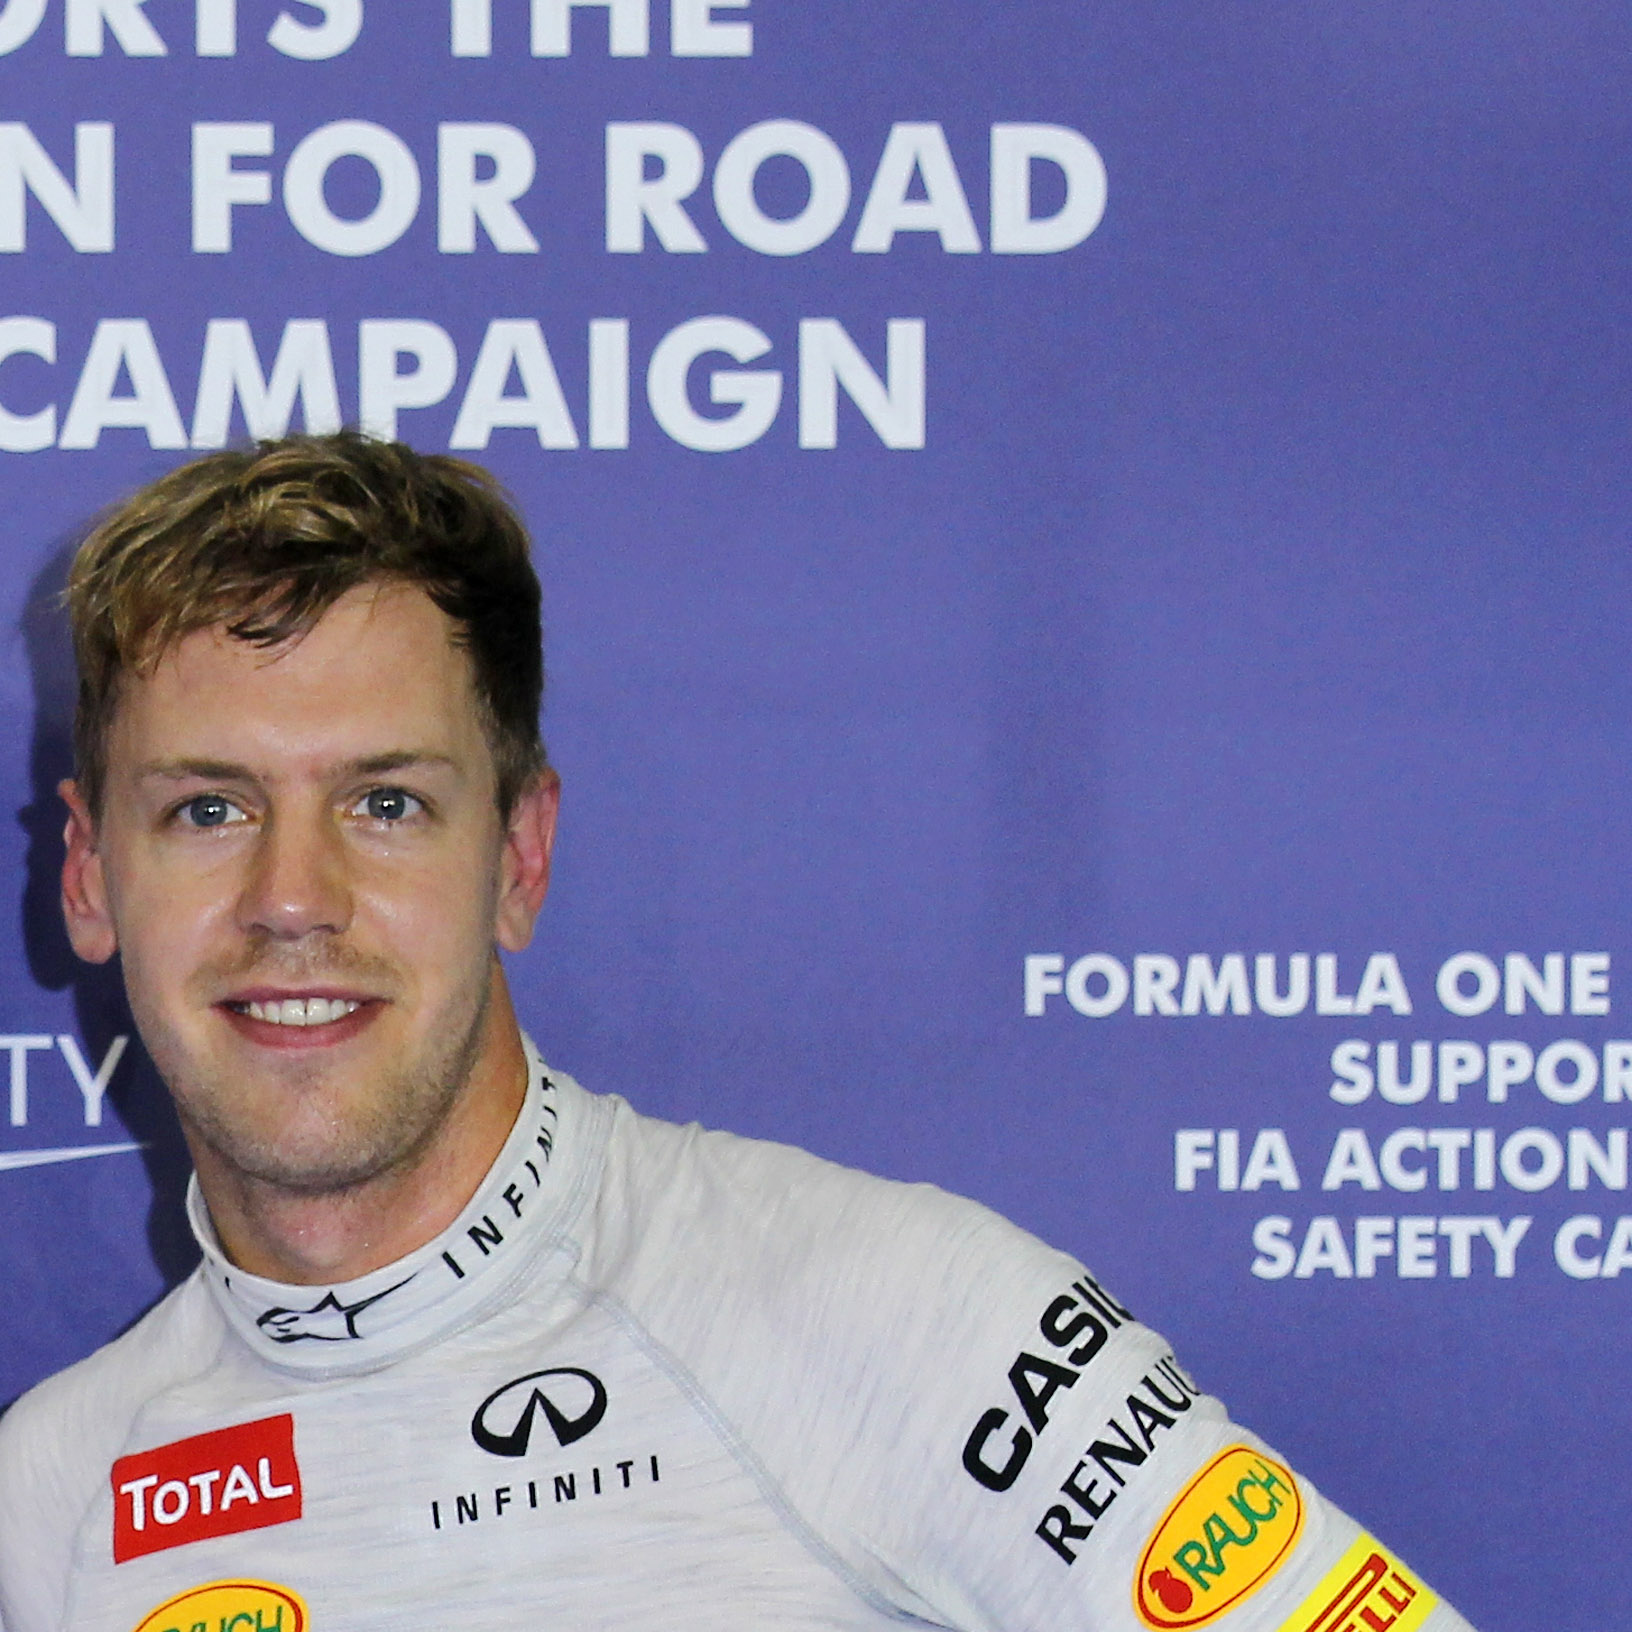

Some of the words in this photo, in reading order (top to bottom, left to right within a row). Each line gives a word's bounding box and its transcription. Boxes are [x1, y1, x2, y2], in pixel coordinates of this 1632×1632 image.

[191, 118, 539, 255] FOR
[605, 119, 1110, 256] ROAD
[1024, 953, 1412, 1018] FORMULA
[1435, 952, 1611, 1017] ONE
[1174, 1126, 1300, 1192] FIA
[1321, 1126, 1629, 1192] ACTION
[1250, 1215, 1534, 1279] SAFETY
[431, 1454, 661, 1530] INFINITI
[1172, 1458, 1291, 1592] RAUCH
